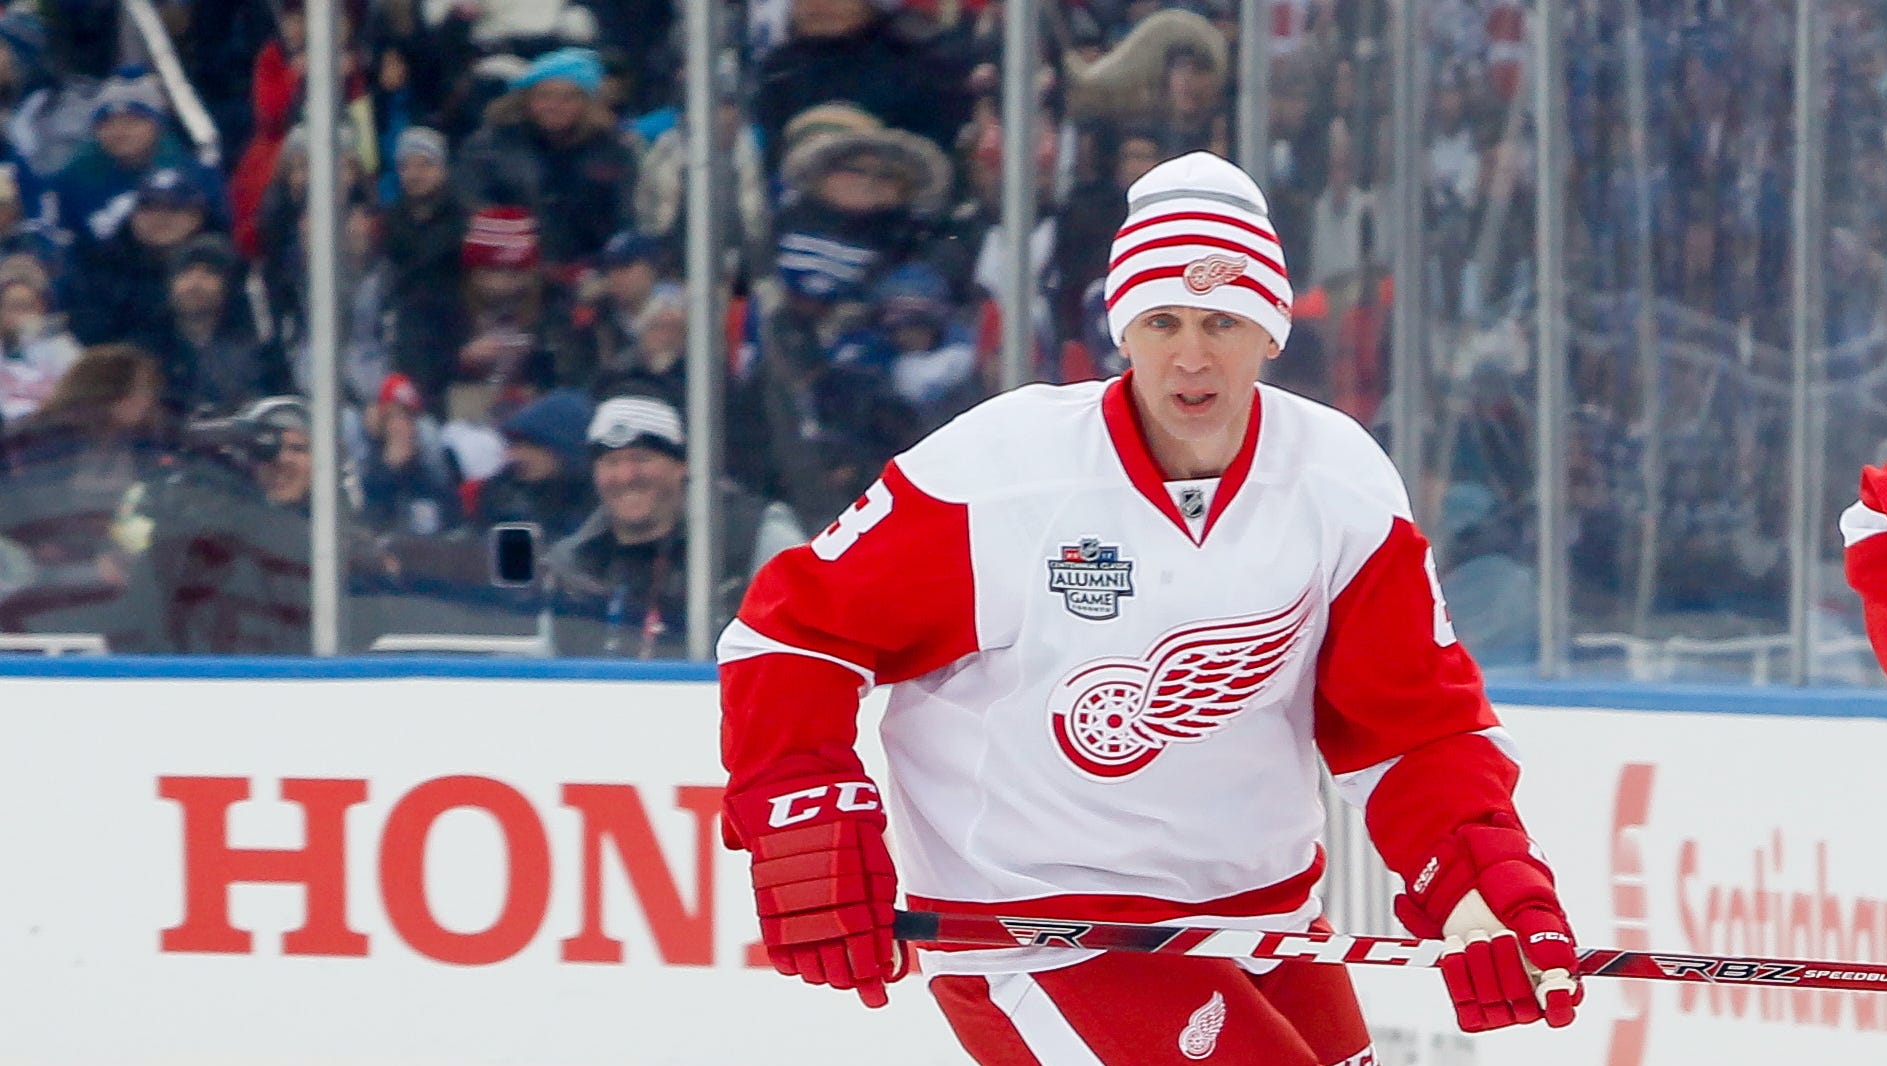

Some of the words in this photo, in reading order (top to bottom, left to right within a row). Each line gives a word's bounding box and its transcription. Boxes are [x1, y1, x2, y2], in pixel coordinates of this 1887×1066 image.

[1056, 571, 1126, 587] ALUMNI
[1069, 592, 1113, 605] GAME
[768, 782, 886, 828] CC
[155, 774, 780, 976] HON
[1651, 955, 1804, 983] RBZ
